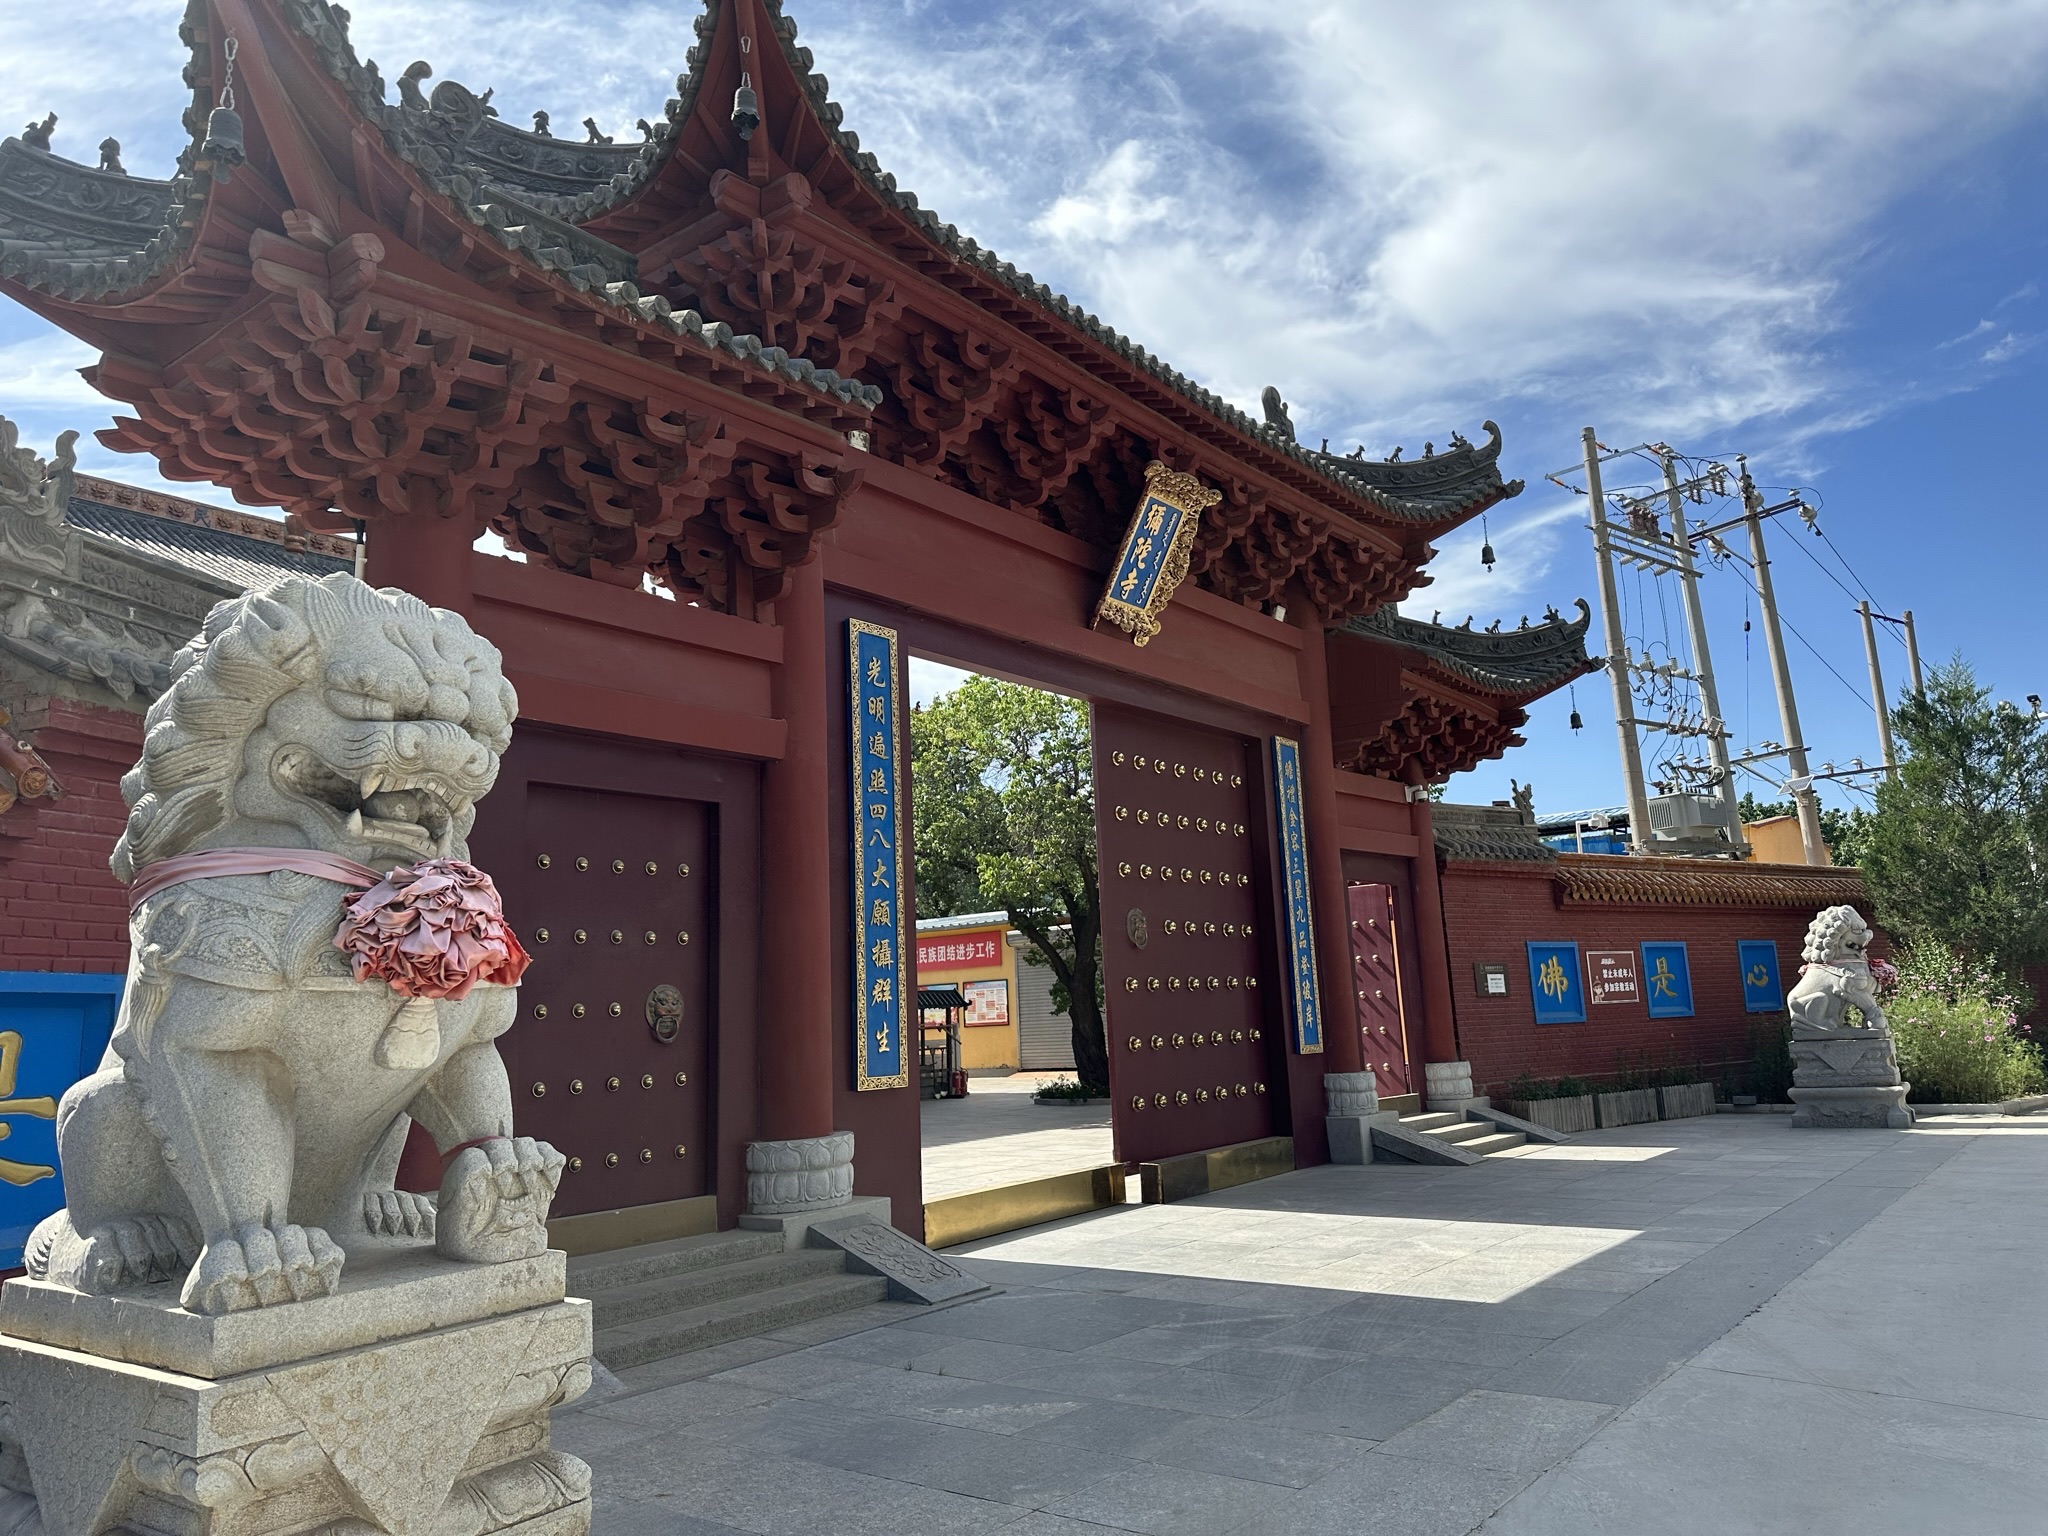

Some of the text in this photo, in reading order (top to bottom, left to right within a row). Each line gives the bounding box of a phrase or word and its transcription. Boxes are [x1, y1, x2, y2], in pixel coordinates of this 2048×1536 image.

[917, 941, 995, 963] 民族团结进步工作
[1538, 955, 1569, 1003] 佛
[1602, 968, 1633, 978] 禁止未成年人
[1650, 956, 1678, 997] 是
[1747, 964, 1769, 987] 心
